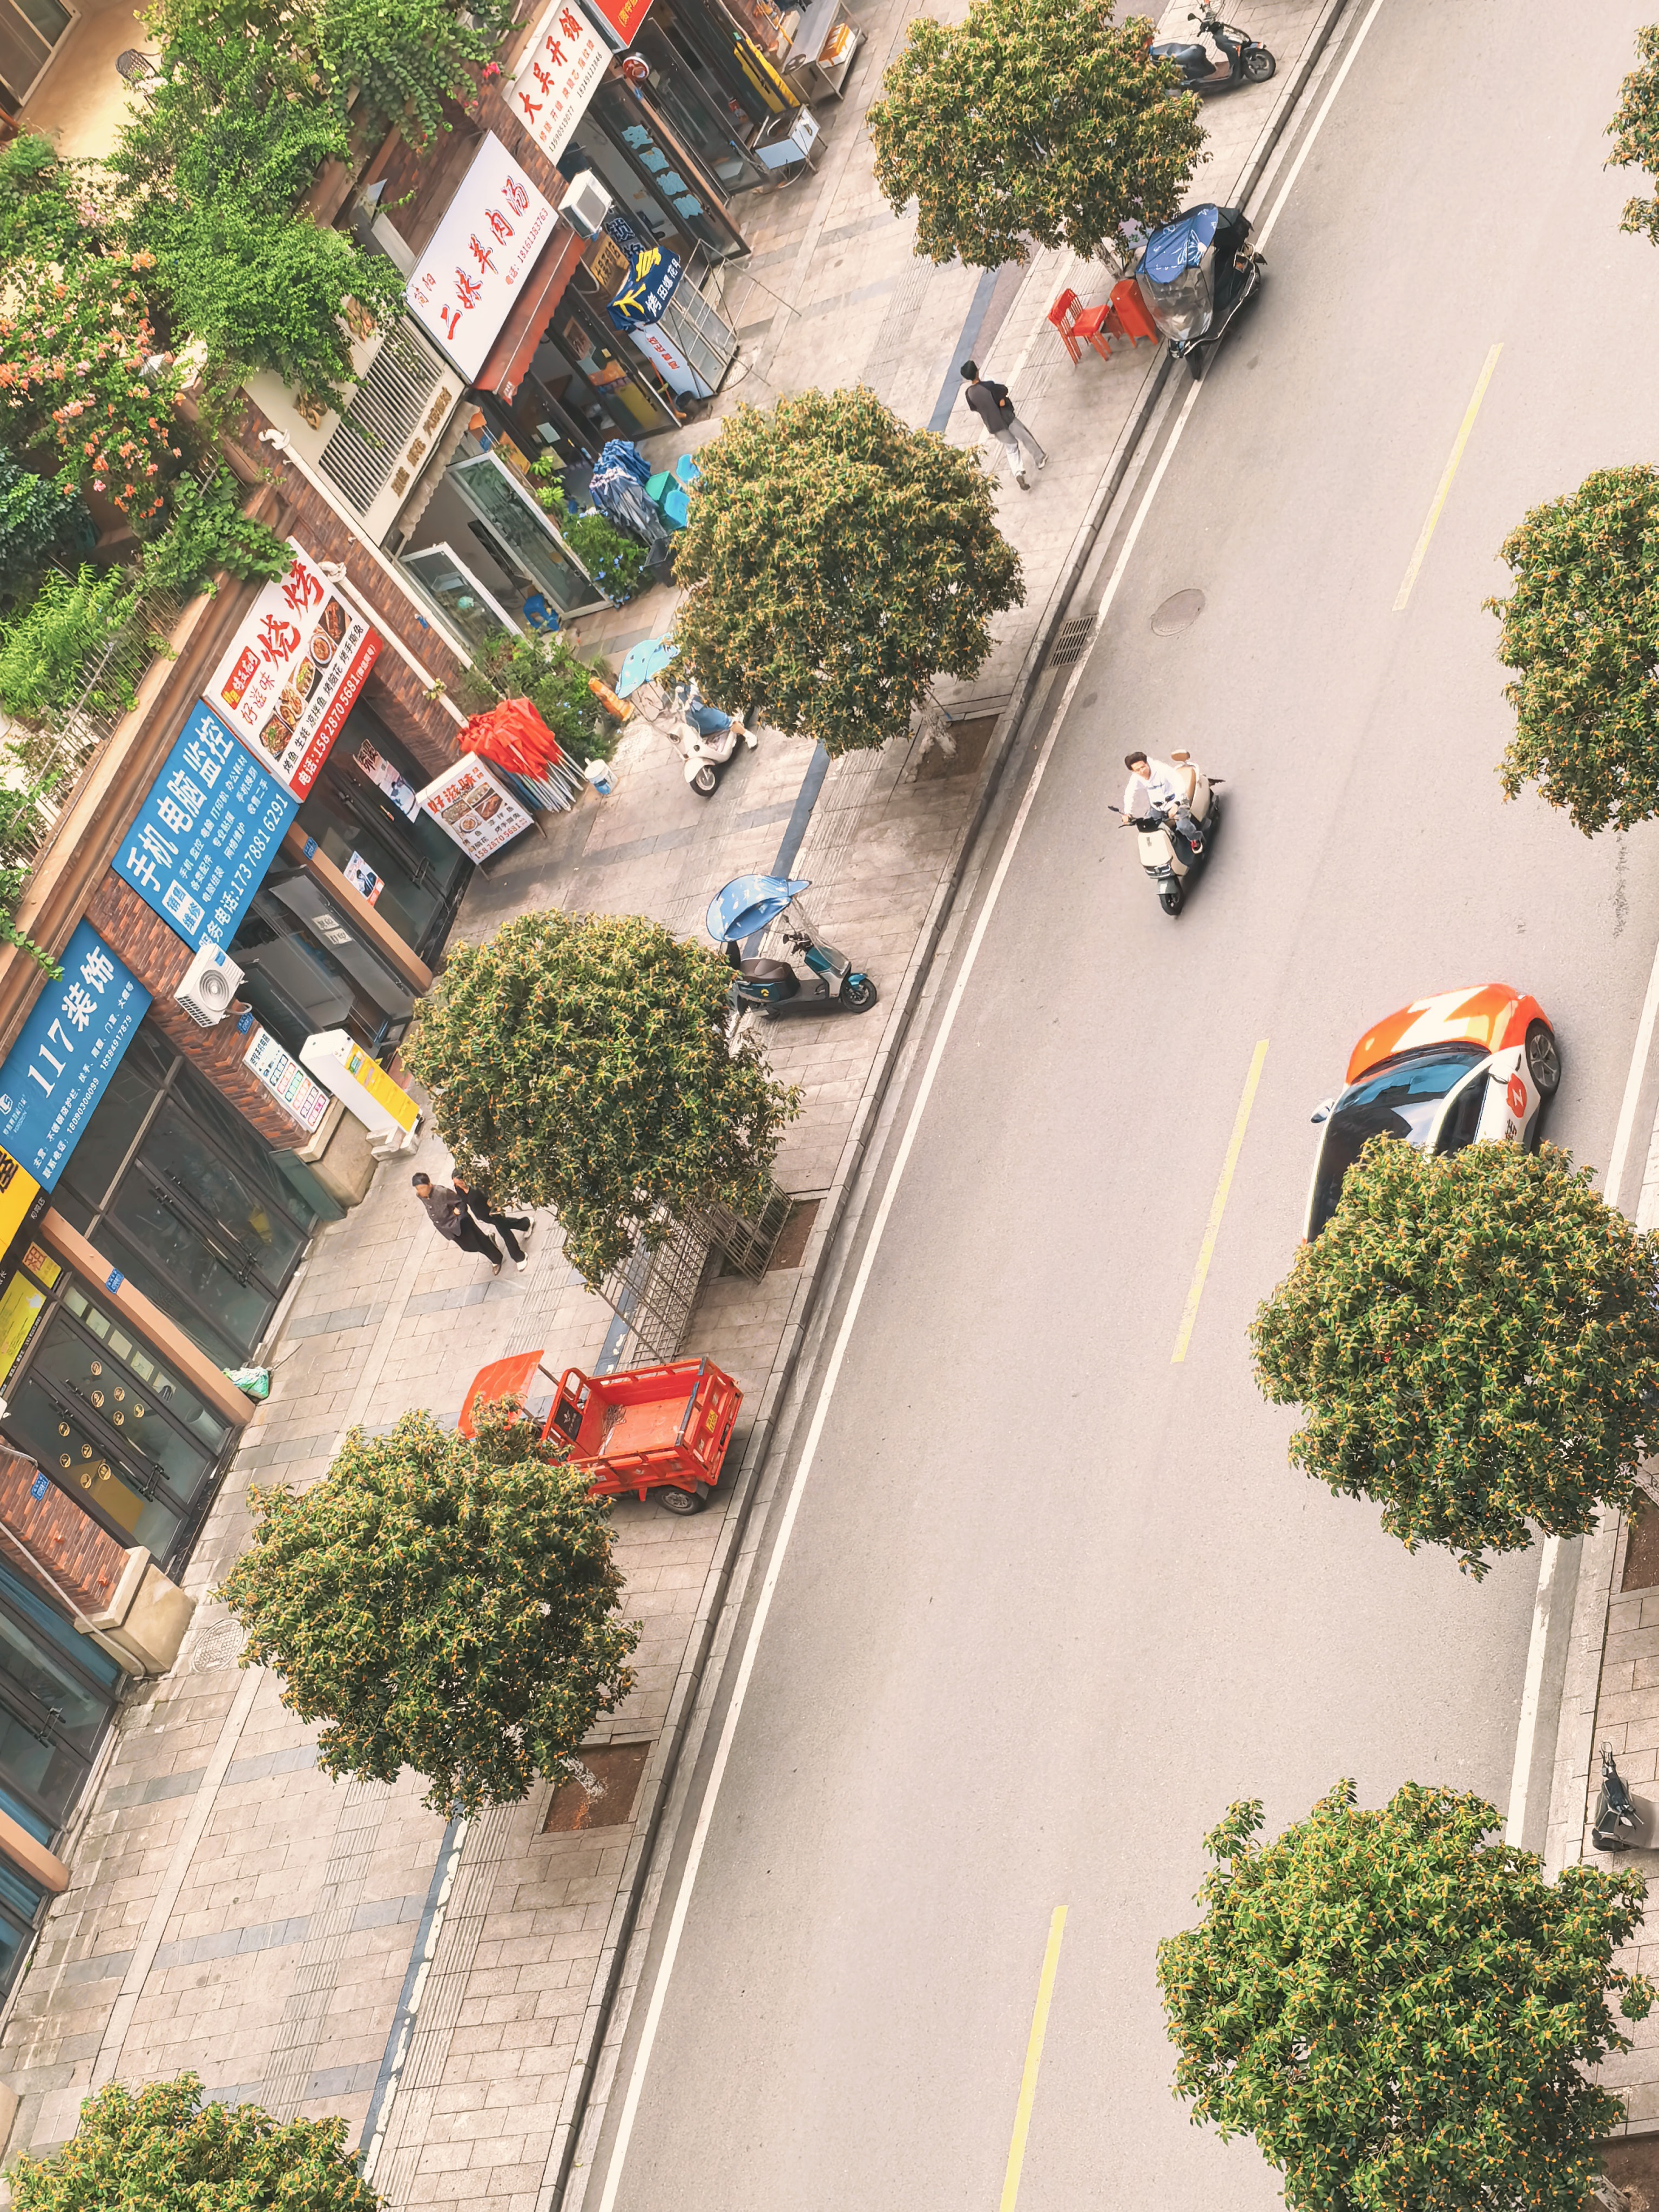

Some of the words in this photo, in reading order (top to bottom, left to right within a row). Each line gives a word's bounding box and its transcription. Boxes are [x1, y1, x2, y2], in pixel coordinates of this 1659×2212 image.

[518, 8, 583, 125] 大吴开锁
[440, 176, 530, 340] 二妹羊肉汤
[257, 561, 324, 670] 烧烤
[241, 672, 275, 725] 好滋味
[282, 752, 299, 774] 烤鱼
[295, 727, 311, 750] 生蚝
[306, 696, 327, 728] 凉拌鱼
[325, 704, 345, 736] 2870
[244, 827, 271, 867] 7881
[265, 792, 289, 832] 6291
[475, 849, 489, 859] 158
[487, 835, 505, 850] 2870
[503, 823, 521, 838] 5681
[28, 946, 115, 1099] 117装饰
